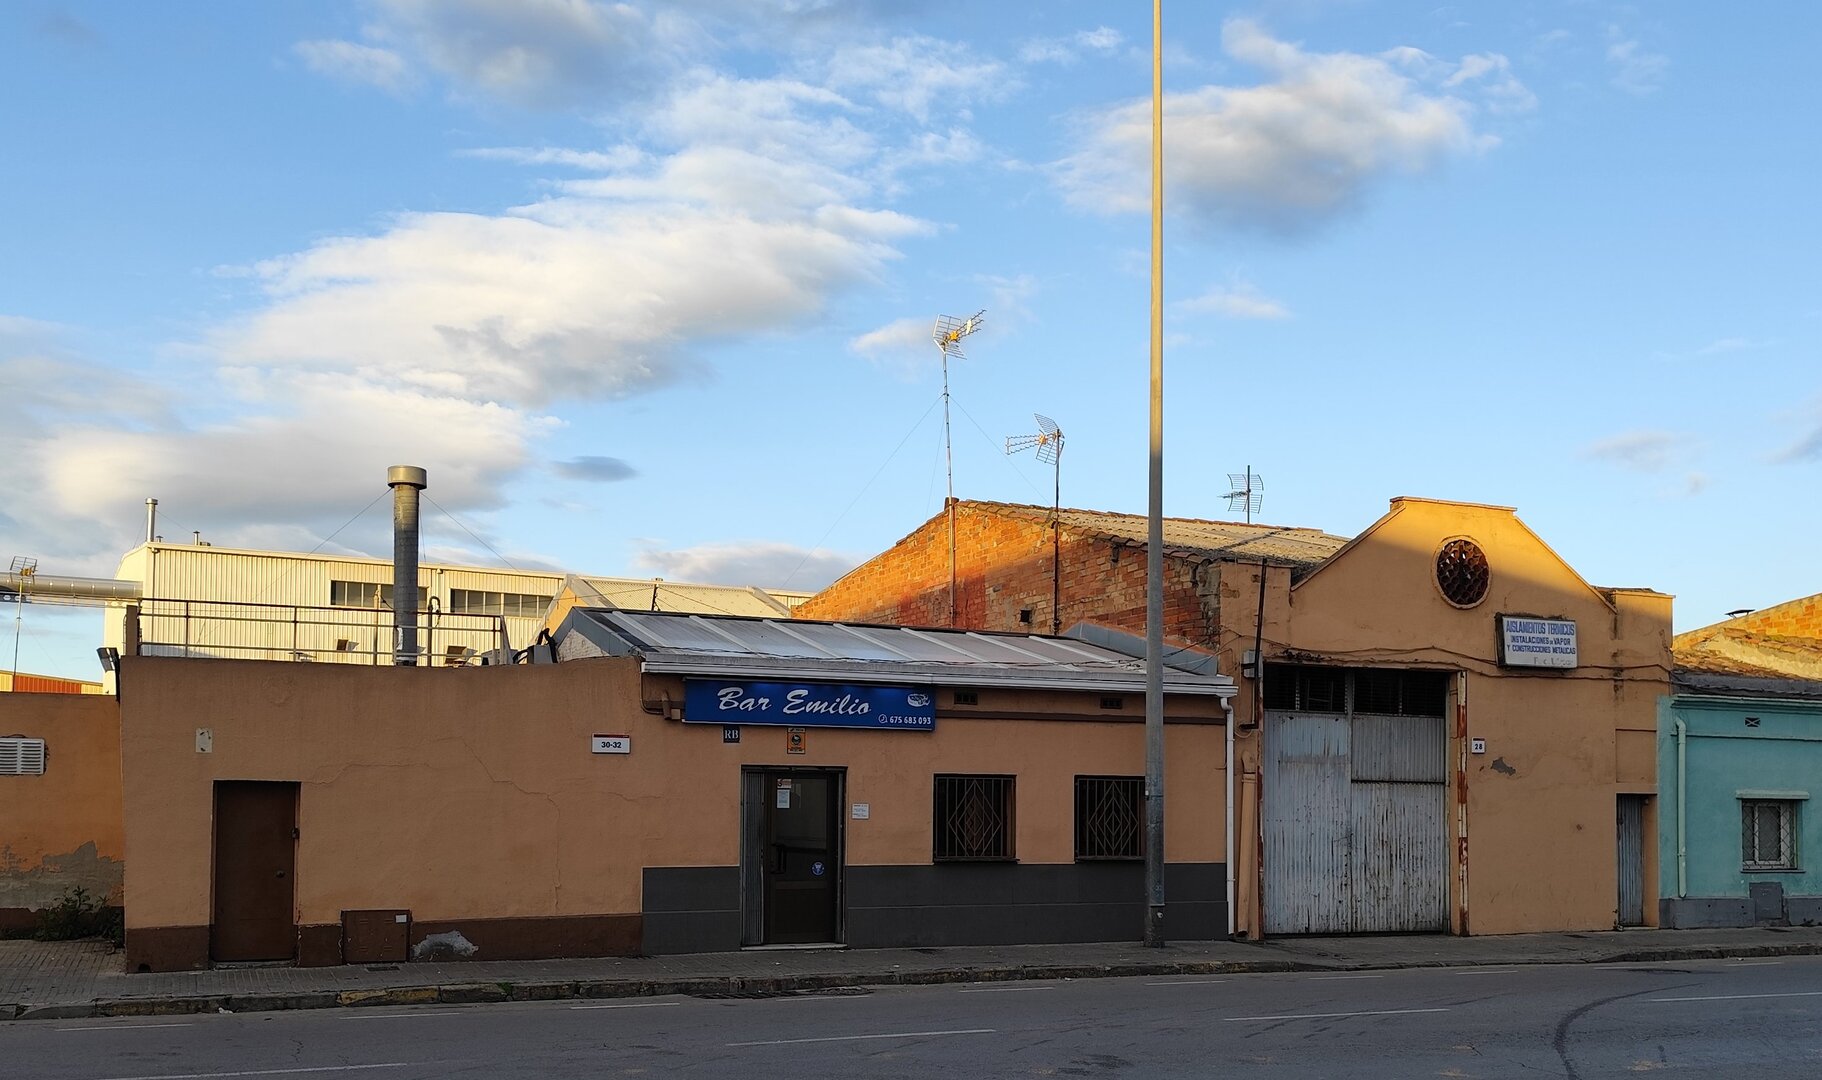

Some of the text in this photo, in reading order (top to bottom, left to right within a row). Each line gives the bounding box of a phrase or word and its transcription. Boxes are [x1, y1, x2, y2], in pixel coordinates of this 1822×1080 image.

[1511, 636, 1549, 644] INSTALACIONES
[1554, 638, 1571, 646] VAPOR
[1512, 645, 1551, 654] CONSTRUCCIONES
[717, 686, 872, 715] Bar Emilio
[890, 716, 932, 724] 675 683 093
[724, 729, 739, 739] RB
